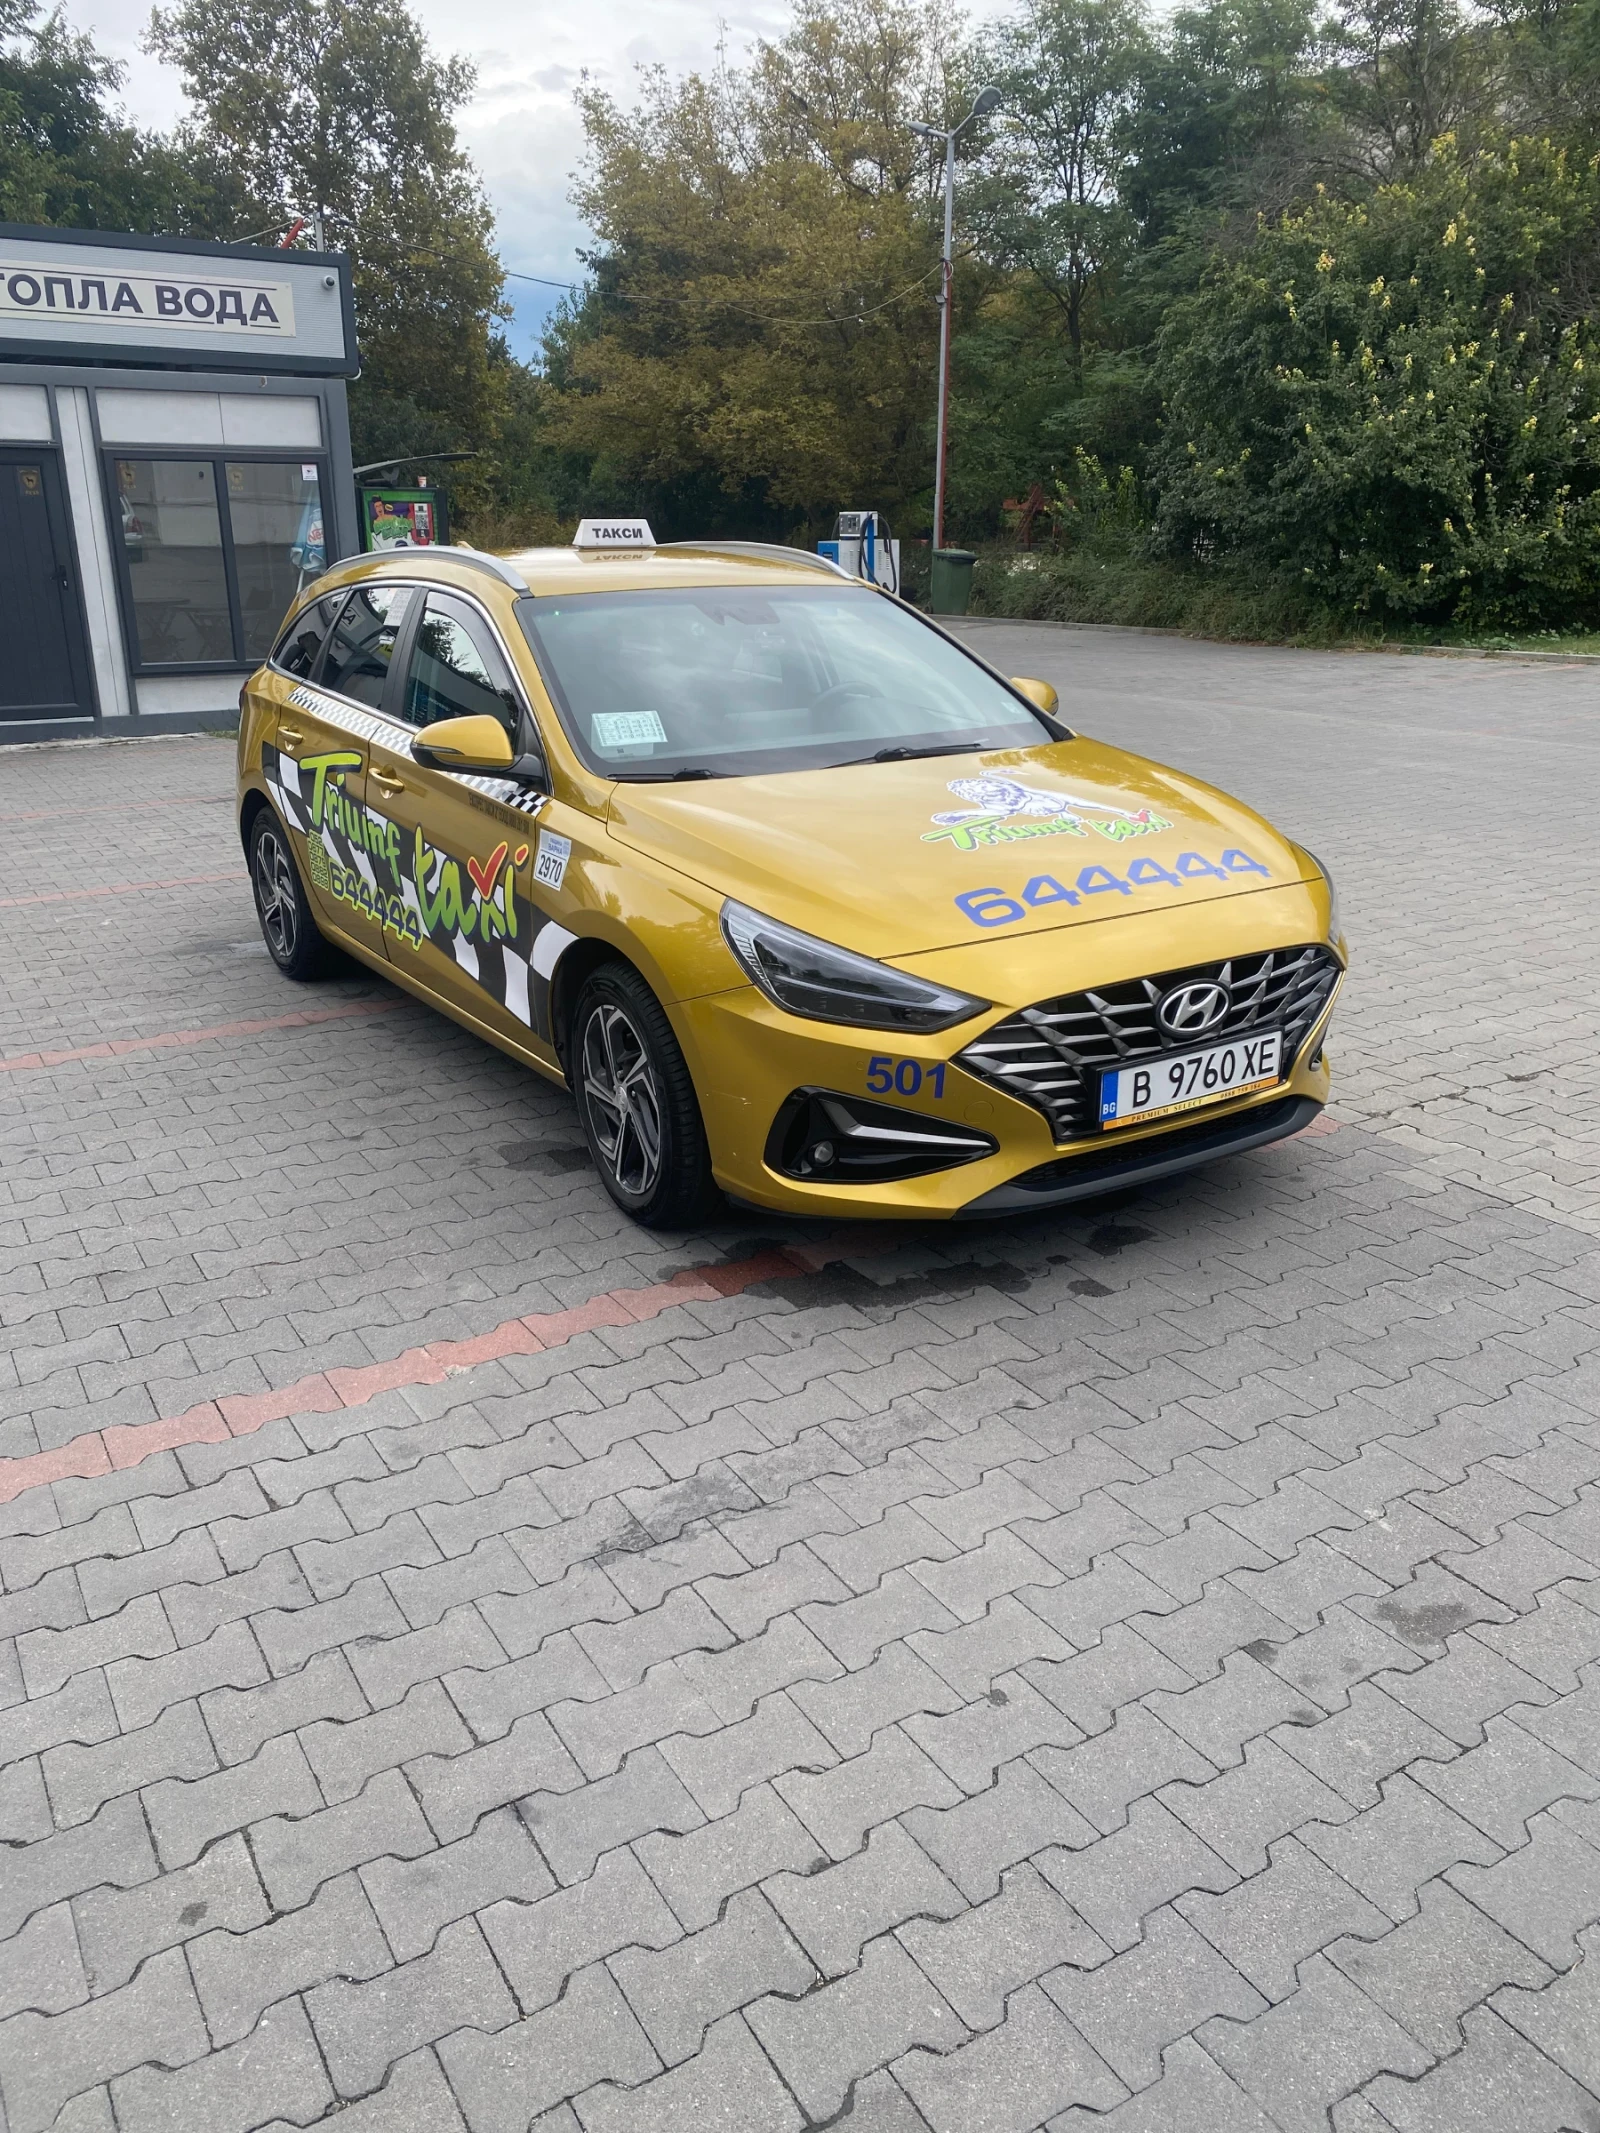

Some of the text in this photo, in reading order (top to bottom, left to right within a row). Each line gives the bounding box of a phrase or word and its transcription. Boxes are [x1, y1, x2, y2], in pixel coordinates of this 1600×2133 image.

[0, 273, 279, 326] ОПЛА ВОДА
[592, 528, 643, 538] ТАКСИ
[300, 752, 529, 943] Triumf taxi
[921, 809, 1173, 849] Triumf taxi
[538, 854, 562, 883] 2970
[954, 849, 1272, 927] 644444
[329, 859, 422, 949] 644444
[866, 1056, 946, 1098] 501
[1132, 1038, 1276, 1108] B 9760 XE
[1103, 1103, 1116, 1115] BG
[1131, 1107, 1169, 1122] PREMIUM
[1173, 1099, 1203, 1111] SELECT
